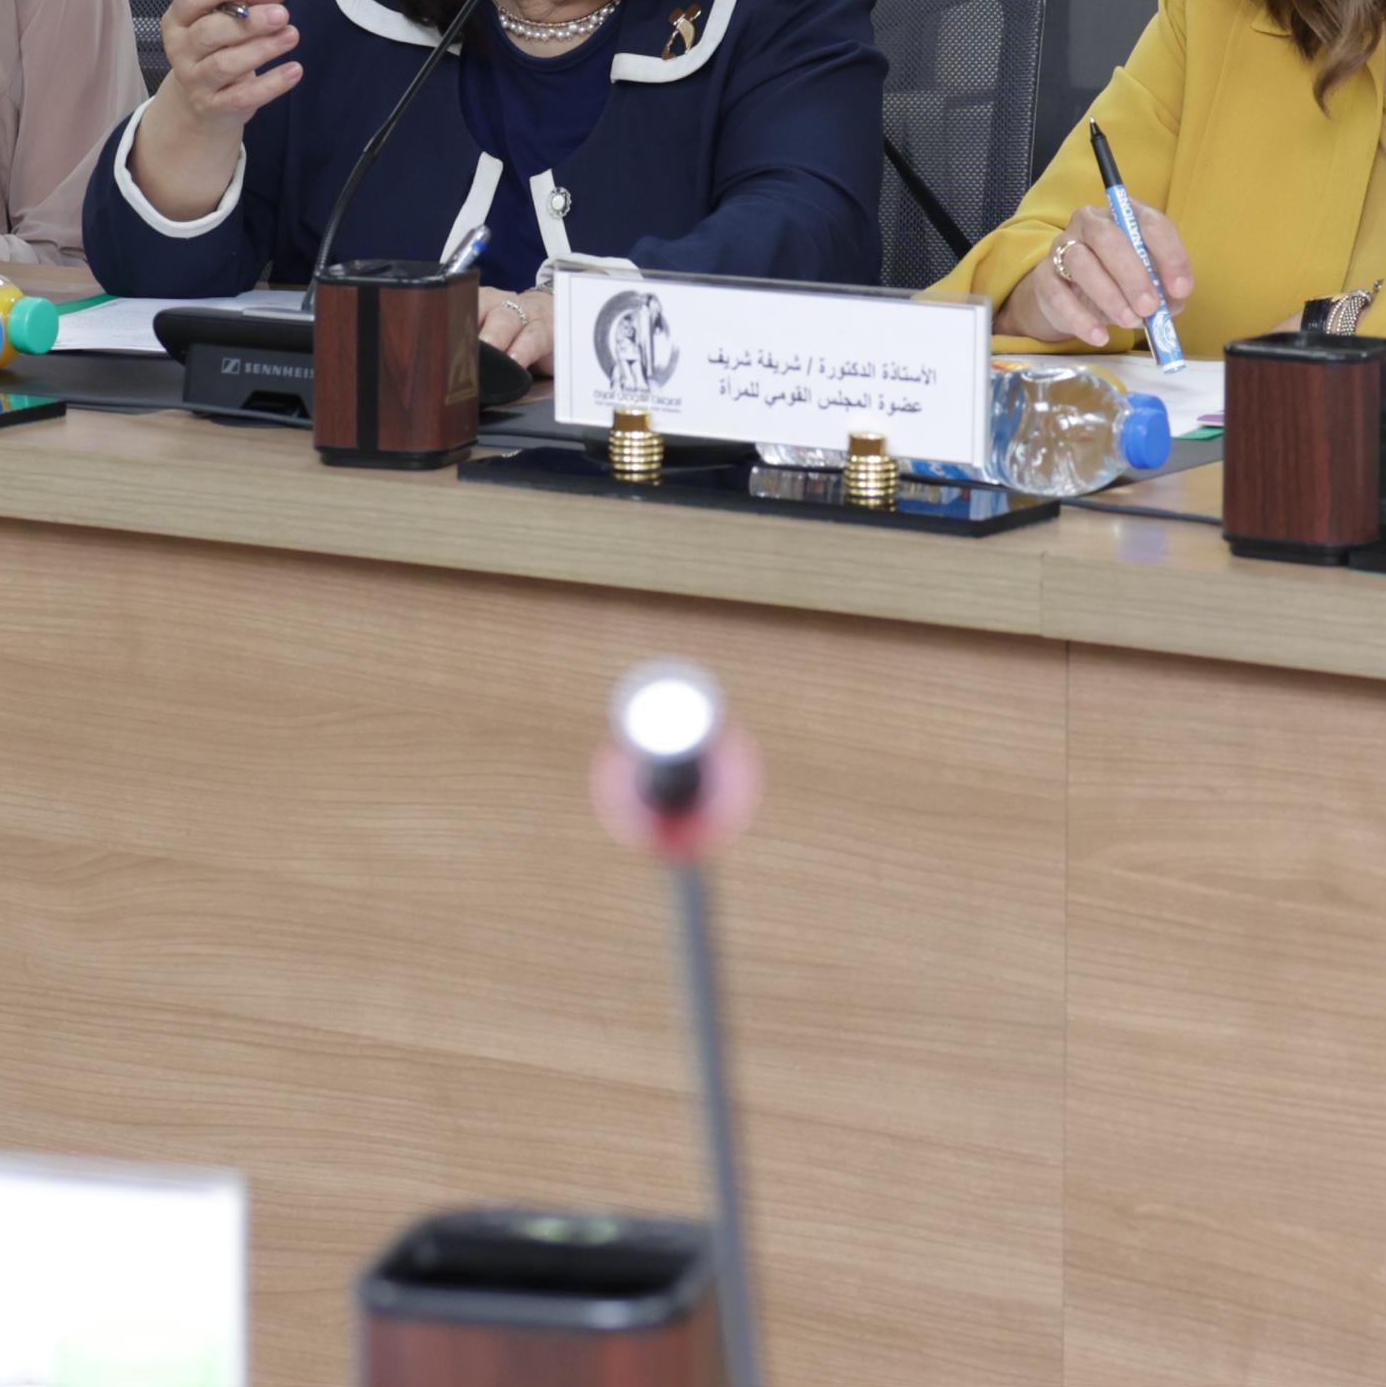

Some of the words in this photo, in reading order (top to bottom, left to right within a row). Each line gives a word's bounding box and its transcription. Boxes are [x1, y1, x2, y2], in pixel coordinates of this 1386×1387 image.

[1115, 187, 1144, 248] NATIONS
[244, 362, 314, 379] SENNHEIS
[720, 379, 759, 401] للمرأة
[765, 386, 811, 407] القومي
[818, 390, 871, 411] المجلس
[879, 394, 922, 416] عضوة
